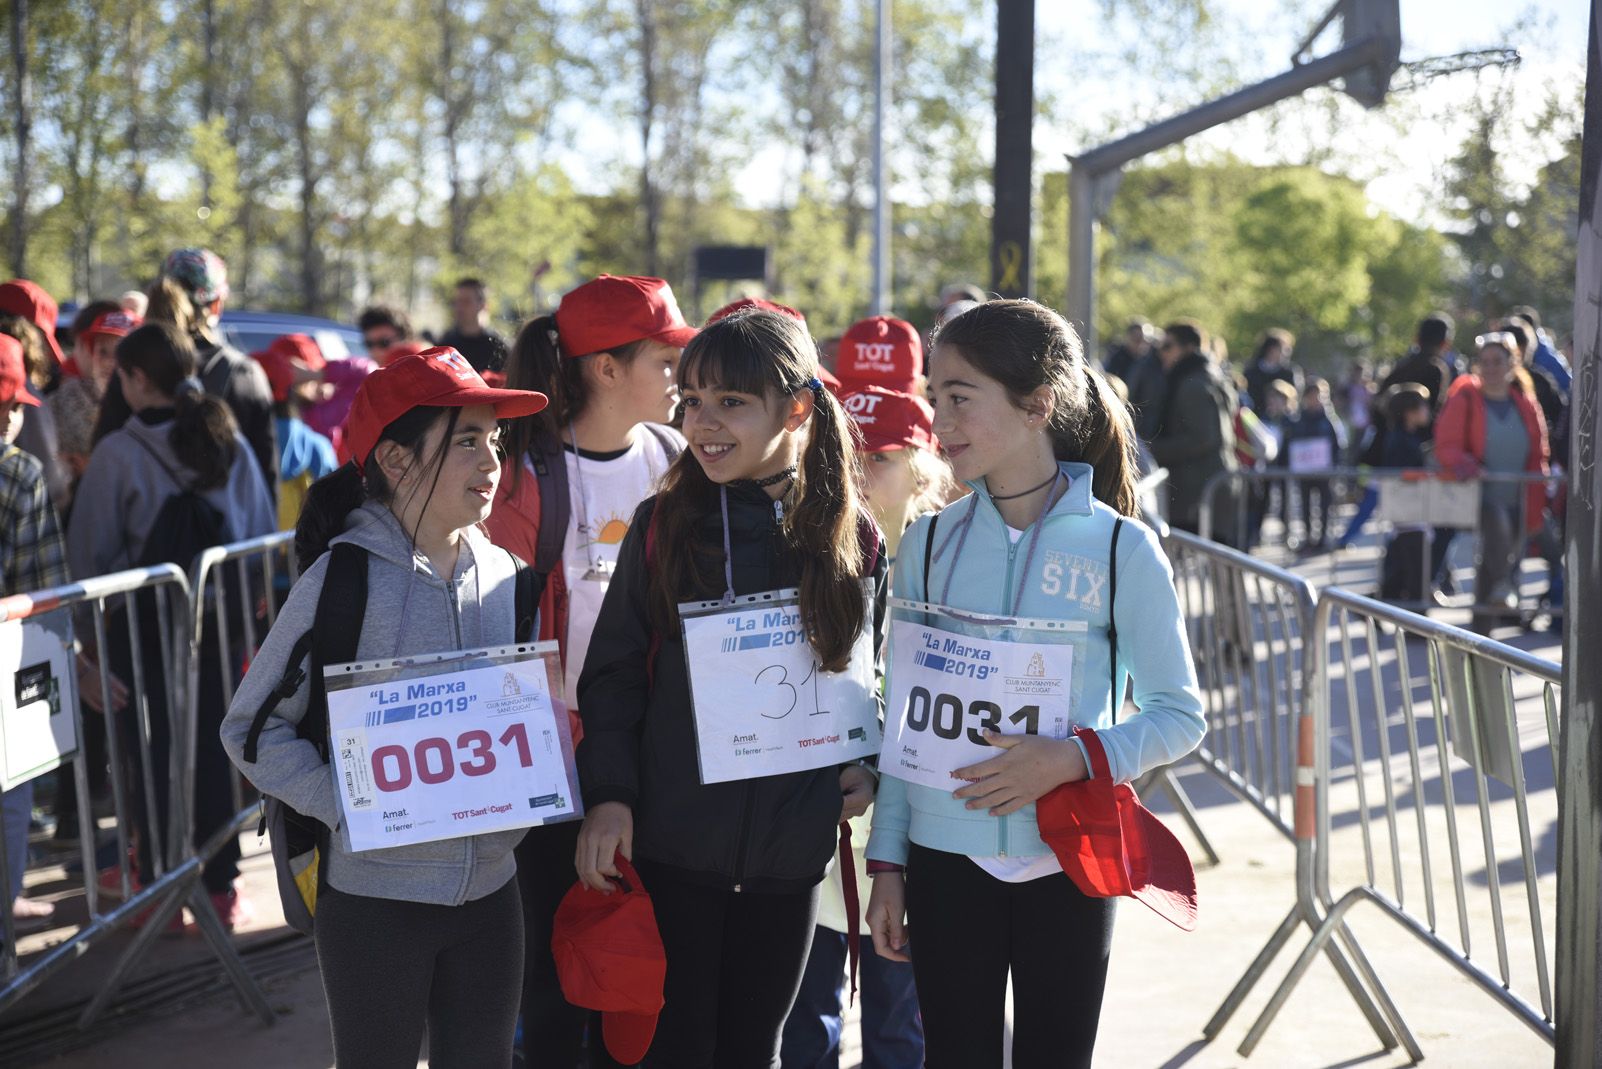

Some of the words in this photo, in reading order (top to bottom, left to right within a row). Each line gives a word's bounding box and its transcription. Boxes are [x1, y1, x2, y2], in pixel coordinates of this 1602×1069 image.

[854, 342, 895, 362] TOT
[1041, 563, 1105, 607] SIX
[942, 638, 991, 661] Marxa
[407, 680, 466, 699] Marxa
[754, 659, 830, 720] 31
[907, 685, 1040, 747] 0031
[346, 738, 356, 746] 31
[371, 722, 534, 793] 0031
[490, 803, 513, 814] Cugat
